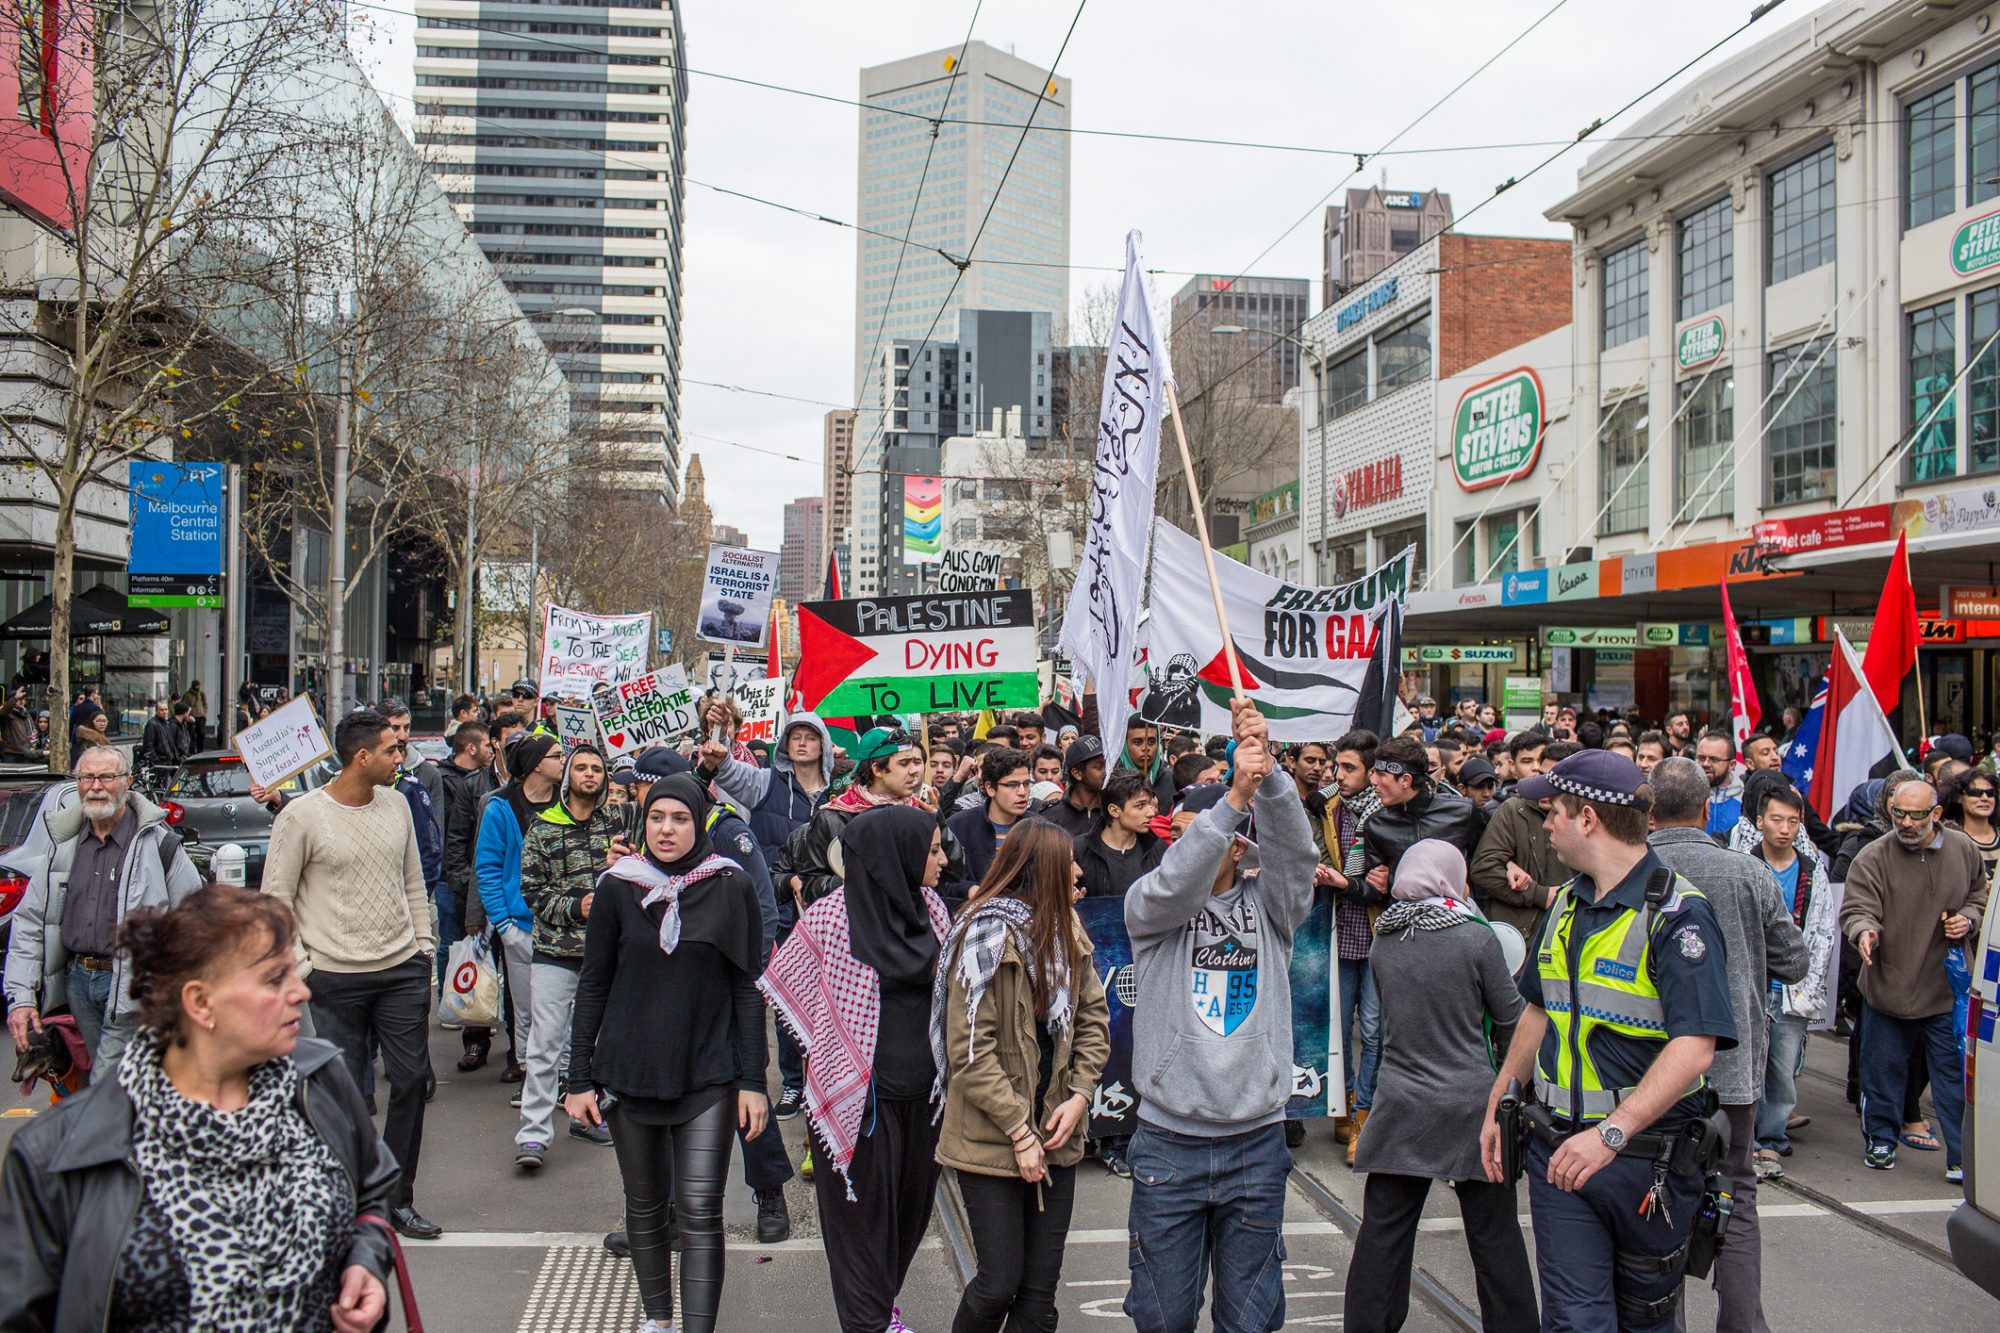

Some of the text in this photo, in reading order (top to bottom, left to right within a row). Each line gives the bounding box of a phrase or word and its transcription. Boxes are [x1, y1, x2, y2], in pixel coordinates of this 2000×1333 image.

[1336, 275, 1399, 334] ITHACA HOUSE
[1686, 321, 1715, 346] PETER
[1681, 333, 1720, 360] STEVENS
[1469, 382, 1522, 431] PETER
[1460, 412, 1533, 466] STEVENS
[1469, 450, 1521, 477] MOTOR CYCLES
[1347, 453, 1403, 513] YAMAHA
[148, 502, 218, 514] Melbourne
[170, 515, 217, 528] Central
[171, 529, 217, 541] Station
[1801, 529, 1822, 547] cafe
[721, 558, 764, 569] ALTERNATIVE
[722, 551, 765, 563] SOCIALIST
[972, 551, 1000, 574] GOVT
[709, 576, 769, 592] TERRORIST
[710, 566, 770, 582] ISRAEL IS A
[1558, 571, 1589, 596] Vespa
[1624, 565, 1655, 581] CITY KTM
[720, 588, 754, 600] STATE
[1464, 593, 1487, 604] HONDA
[857, 596, 1012, 633] PALESTINE
[1954, 600, 2000, 615] intern
[551, 607, 582, 635] FROM
[612, 619, 645, 637] RIVER
[1264, 610, 1318, 658] FOR
[1598, 635, 1637, 645] HON
[566, 636, 641, 662] TO THE SEA
[905, 638, 999, 670] DYING
[1464, 650, 1513, 659] SUZUKI
[260, 687, 280, 698] GPT
[620, 674, 657, 700] FREE
[735, 683, 776, 703] This is
[930, 680, 1006, 709] LIVE
[625, 689, 663, 711] GAZA
[750, 698, 770, 710] ALL
[601, 688, 693, 735] PEACE FOR THE
[760, 709, 767, 718] a
[245, 728, 263, 744] End
[627, 709, 690, 745] WORLD
[251, 724, 295, 757] Australia's
[255, 743, 291, 769] Support
[262, 752, 301, 782] for Israel
[1195, 947, 1257, 969] Clothing
[1597, 961, 1635, 980] Police
[1193, 971, 1254, 999] H 95
[1206, 996, 1250, 1017] A EST
